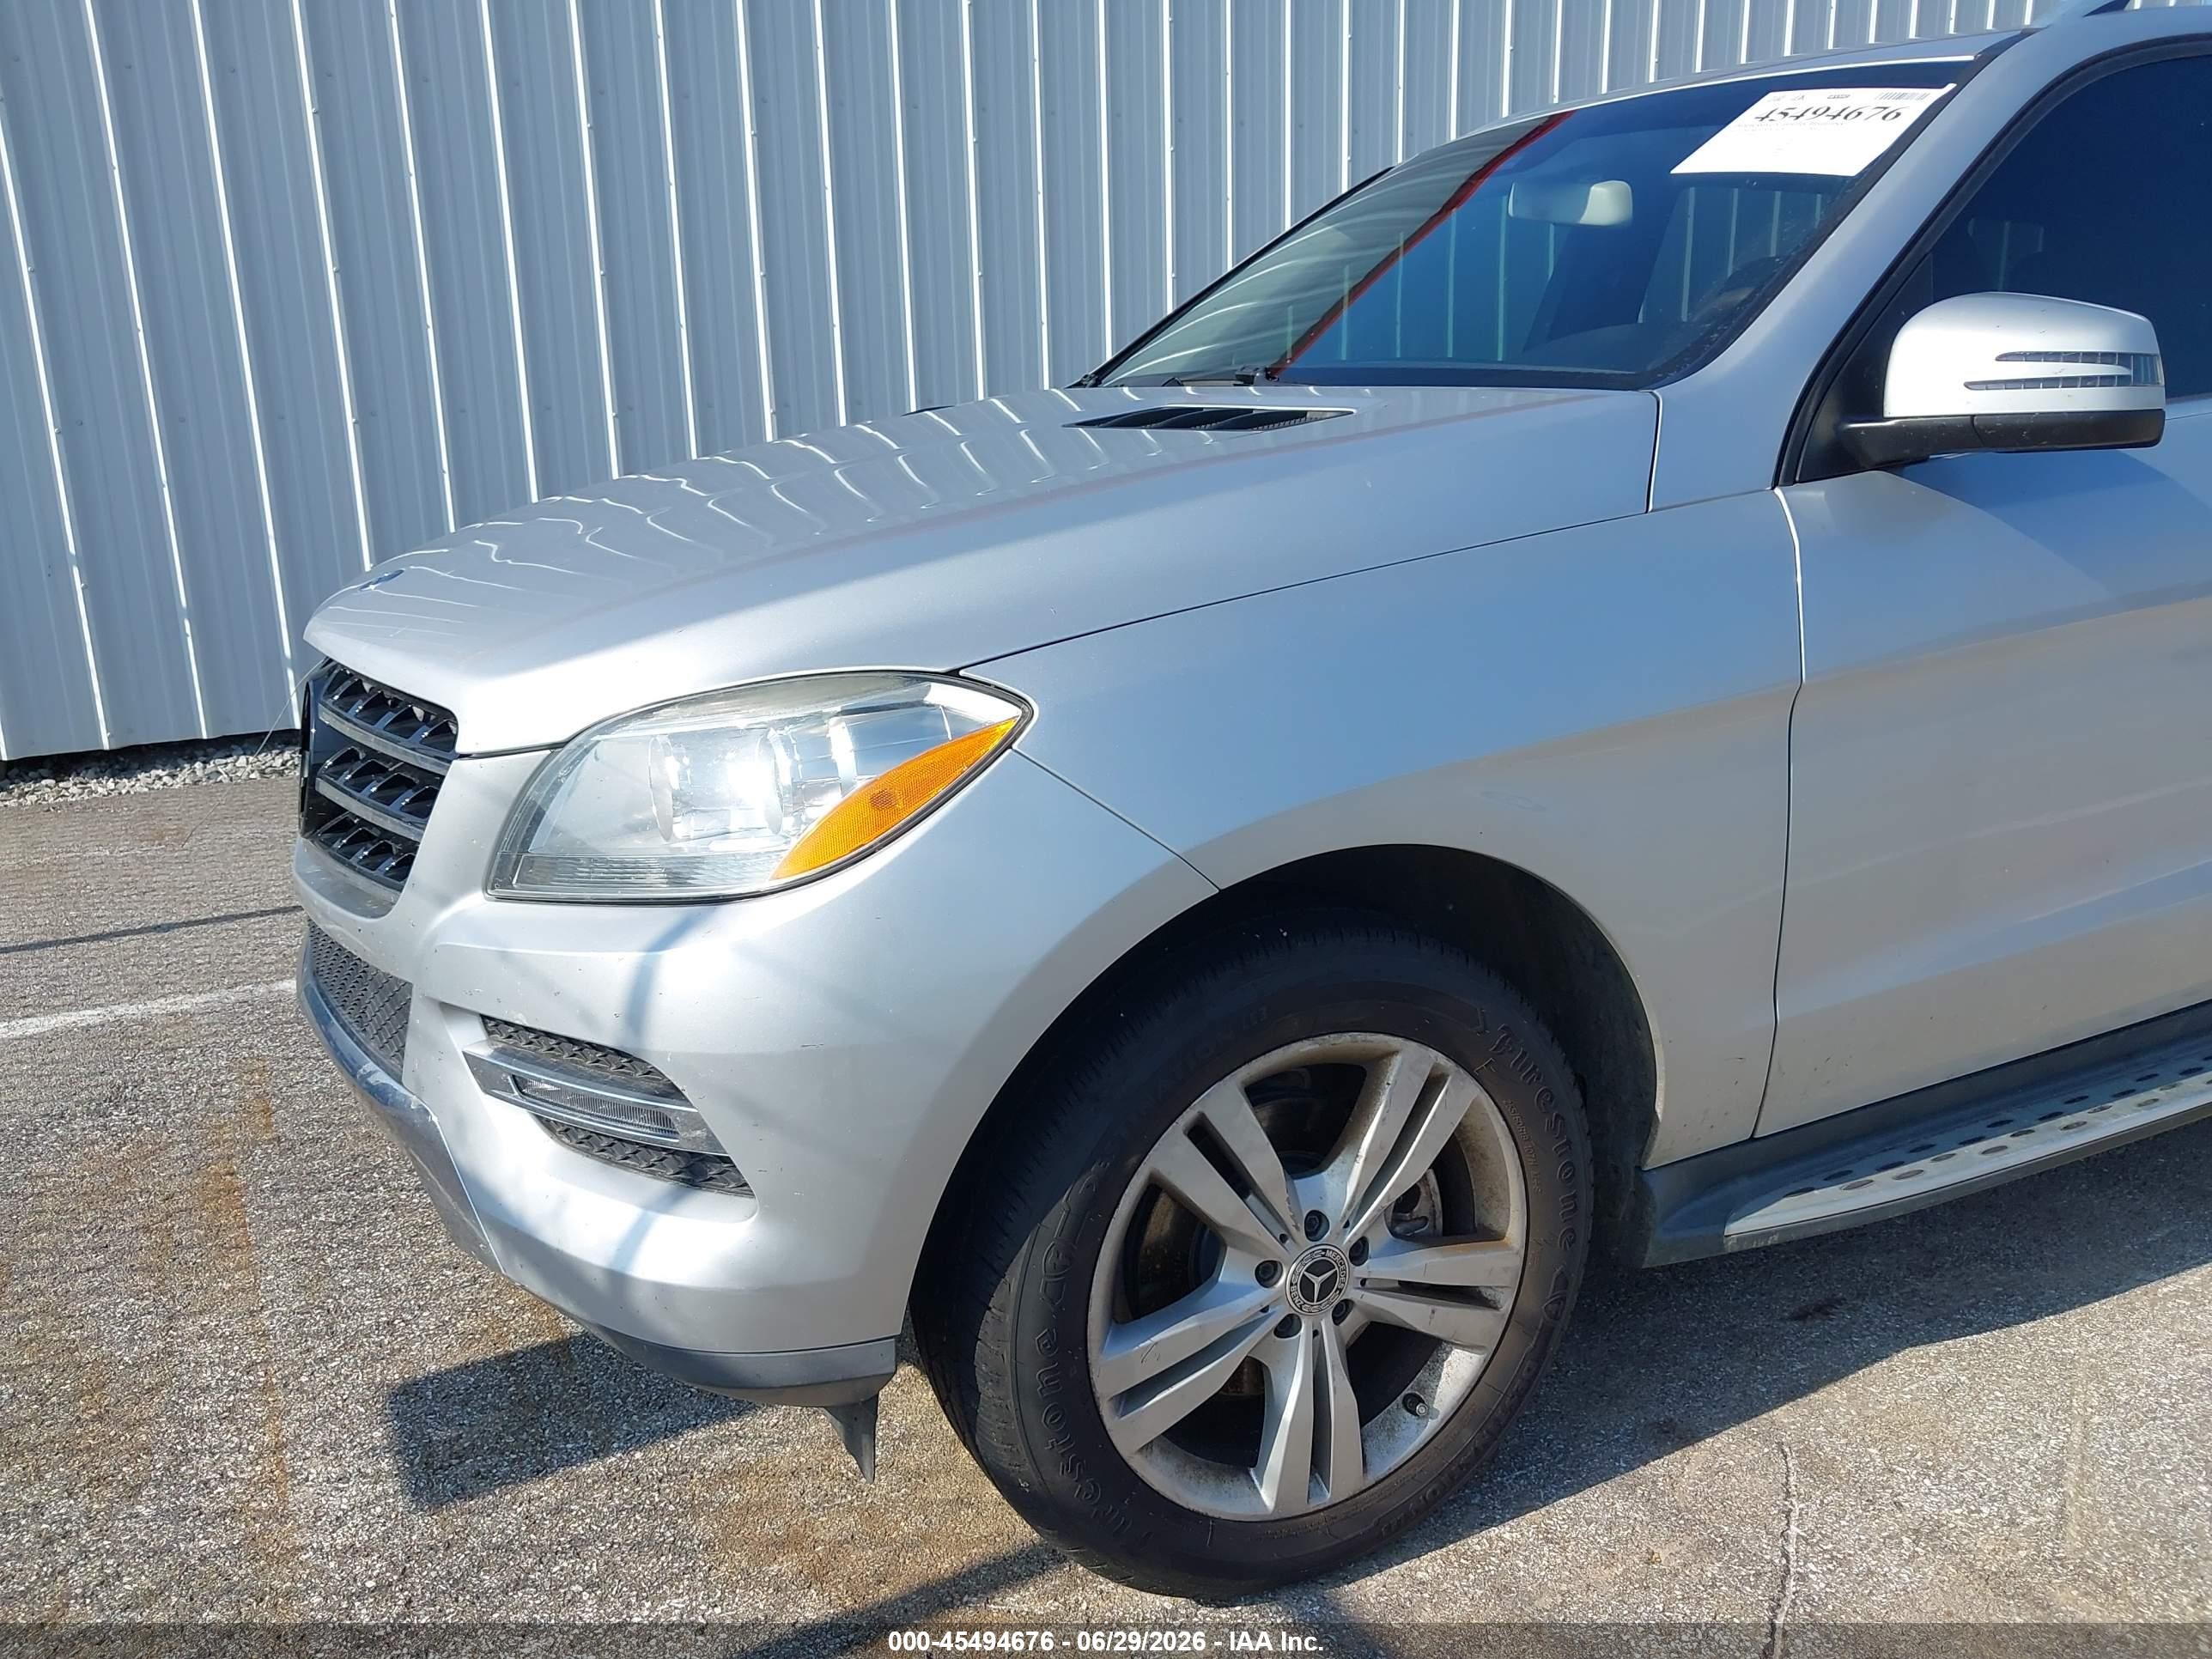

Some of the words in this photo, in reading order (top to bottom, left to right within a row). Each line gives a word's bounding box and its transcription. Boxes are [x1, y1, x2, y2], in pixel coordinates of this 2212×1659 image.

[1754, 106, 1910, 122] 45494676
[1325, 1249, 1346, 1290] MERCEDES
[1290, 1285, 1304, 1307] BENZ
